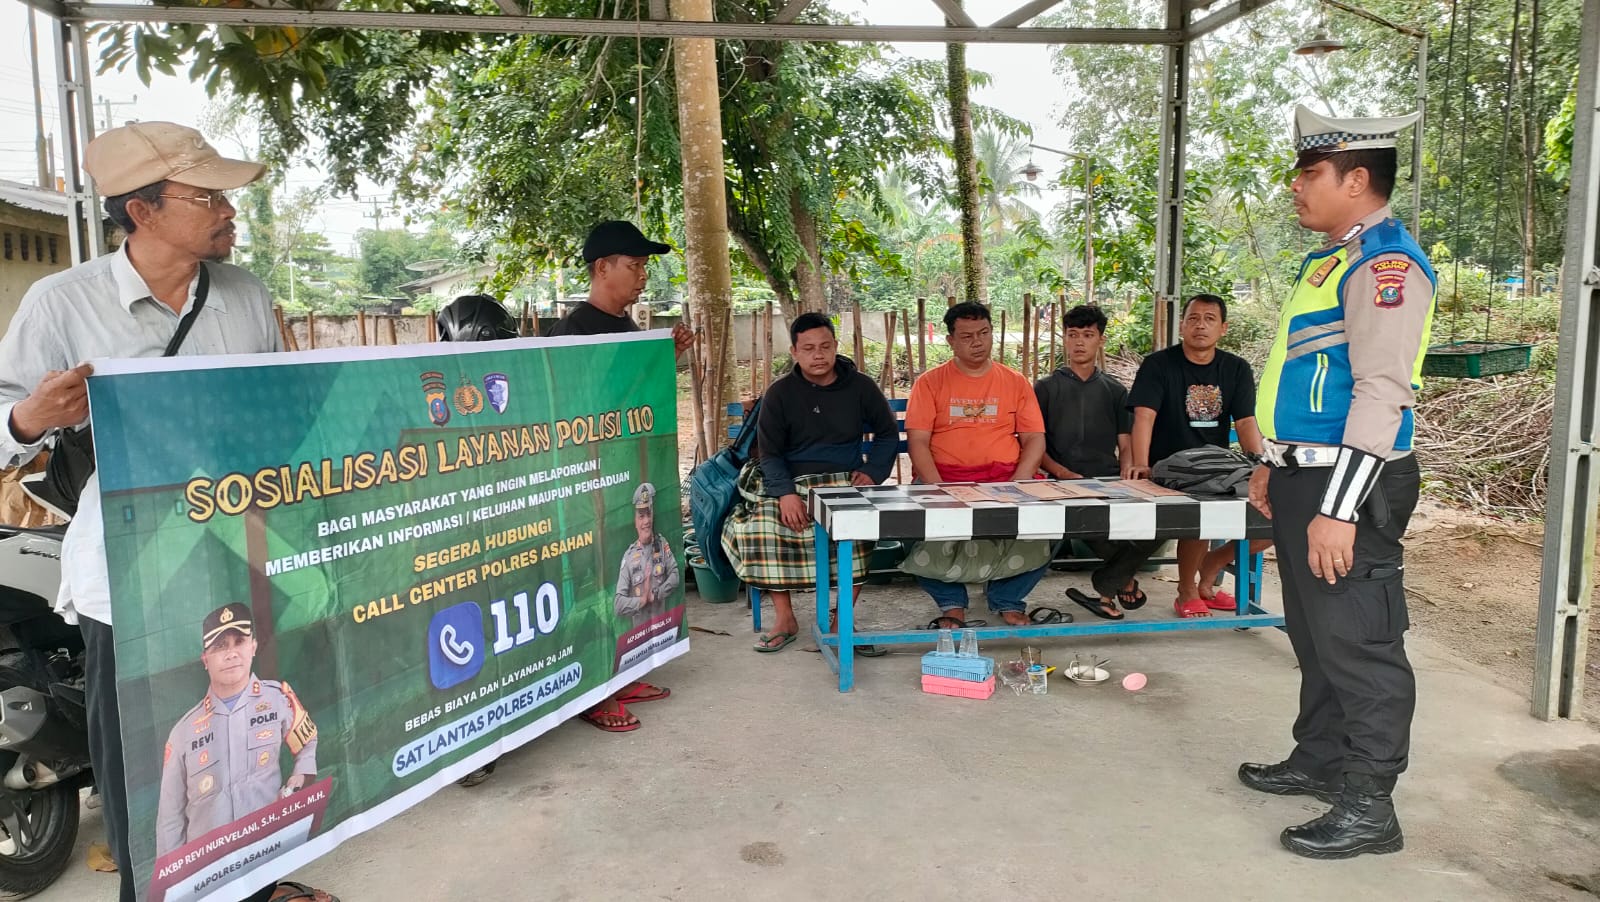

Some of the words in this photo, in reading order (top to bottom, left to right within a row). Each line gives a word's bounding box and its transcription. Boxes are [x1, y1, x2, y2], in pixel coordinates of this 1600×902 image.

[185, 443, 428, 523] SOSIALISASI
[436, 423, 551, 474] LAYANAN
[555, 410, 622, 449] POLISI
[626, 405, 655, 435] 110
[317, 516, 357, 537] BAGI
[361, 492, 457, 527] MASYARAKAT
[460, 484, 493, 503] YANG
[496, 475, 527, 493] INGIN
[529, 460, 596, 485] MELAPORKAN
[265, 534, 384, 577] MEMBERIKAN
[388, 513, 463, 545] INFORMASI
[472, 497, 526, 522] KELUHAN
[528, 484, 573, 508] MAUPUN
[575, 470, 630, 495] PENGADUAN
[413, 539, 481, 573] SEGERA
[485, 518, 552, 550] HUBUNGI
[352, 594, 405, 624] CALL
[409, 568, 478, 605] CENTER
[481, 548, 538, 581] POLRES
[540, 530, 594, 561] ASAHAN
[489, 580, 560, 655] 110
[250, 712, 278, 727] POLRI
[395, 744, 425, 772] SAT
[428, 715, 485, 756] LANTAS
[487, 690, 533, 726] POLRES
[536, 666, 581, 701] ASAHAN
[404, 706, 442, 732] BEBAS
[444, 692, 478, 714] BIAYA
[479, 680, 499, 698] DAN
[501, 659, 545, 687] LAYANAN
[546, 653, 557, 667] 24
[557, 645, 573, 662] JAM
[191, 732, 215, 751] REVI
[158, 858, 184, 880] AKBP
[185, 846, 205, 866] REVI
[205, 822, 260, 854] NURVELANI,
[306, 790, 326, 805] M.H.
[193, 861, 242, 893] KAPOLRES
[242, 841, 281, 866] ASAHAN
